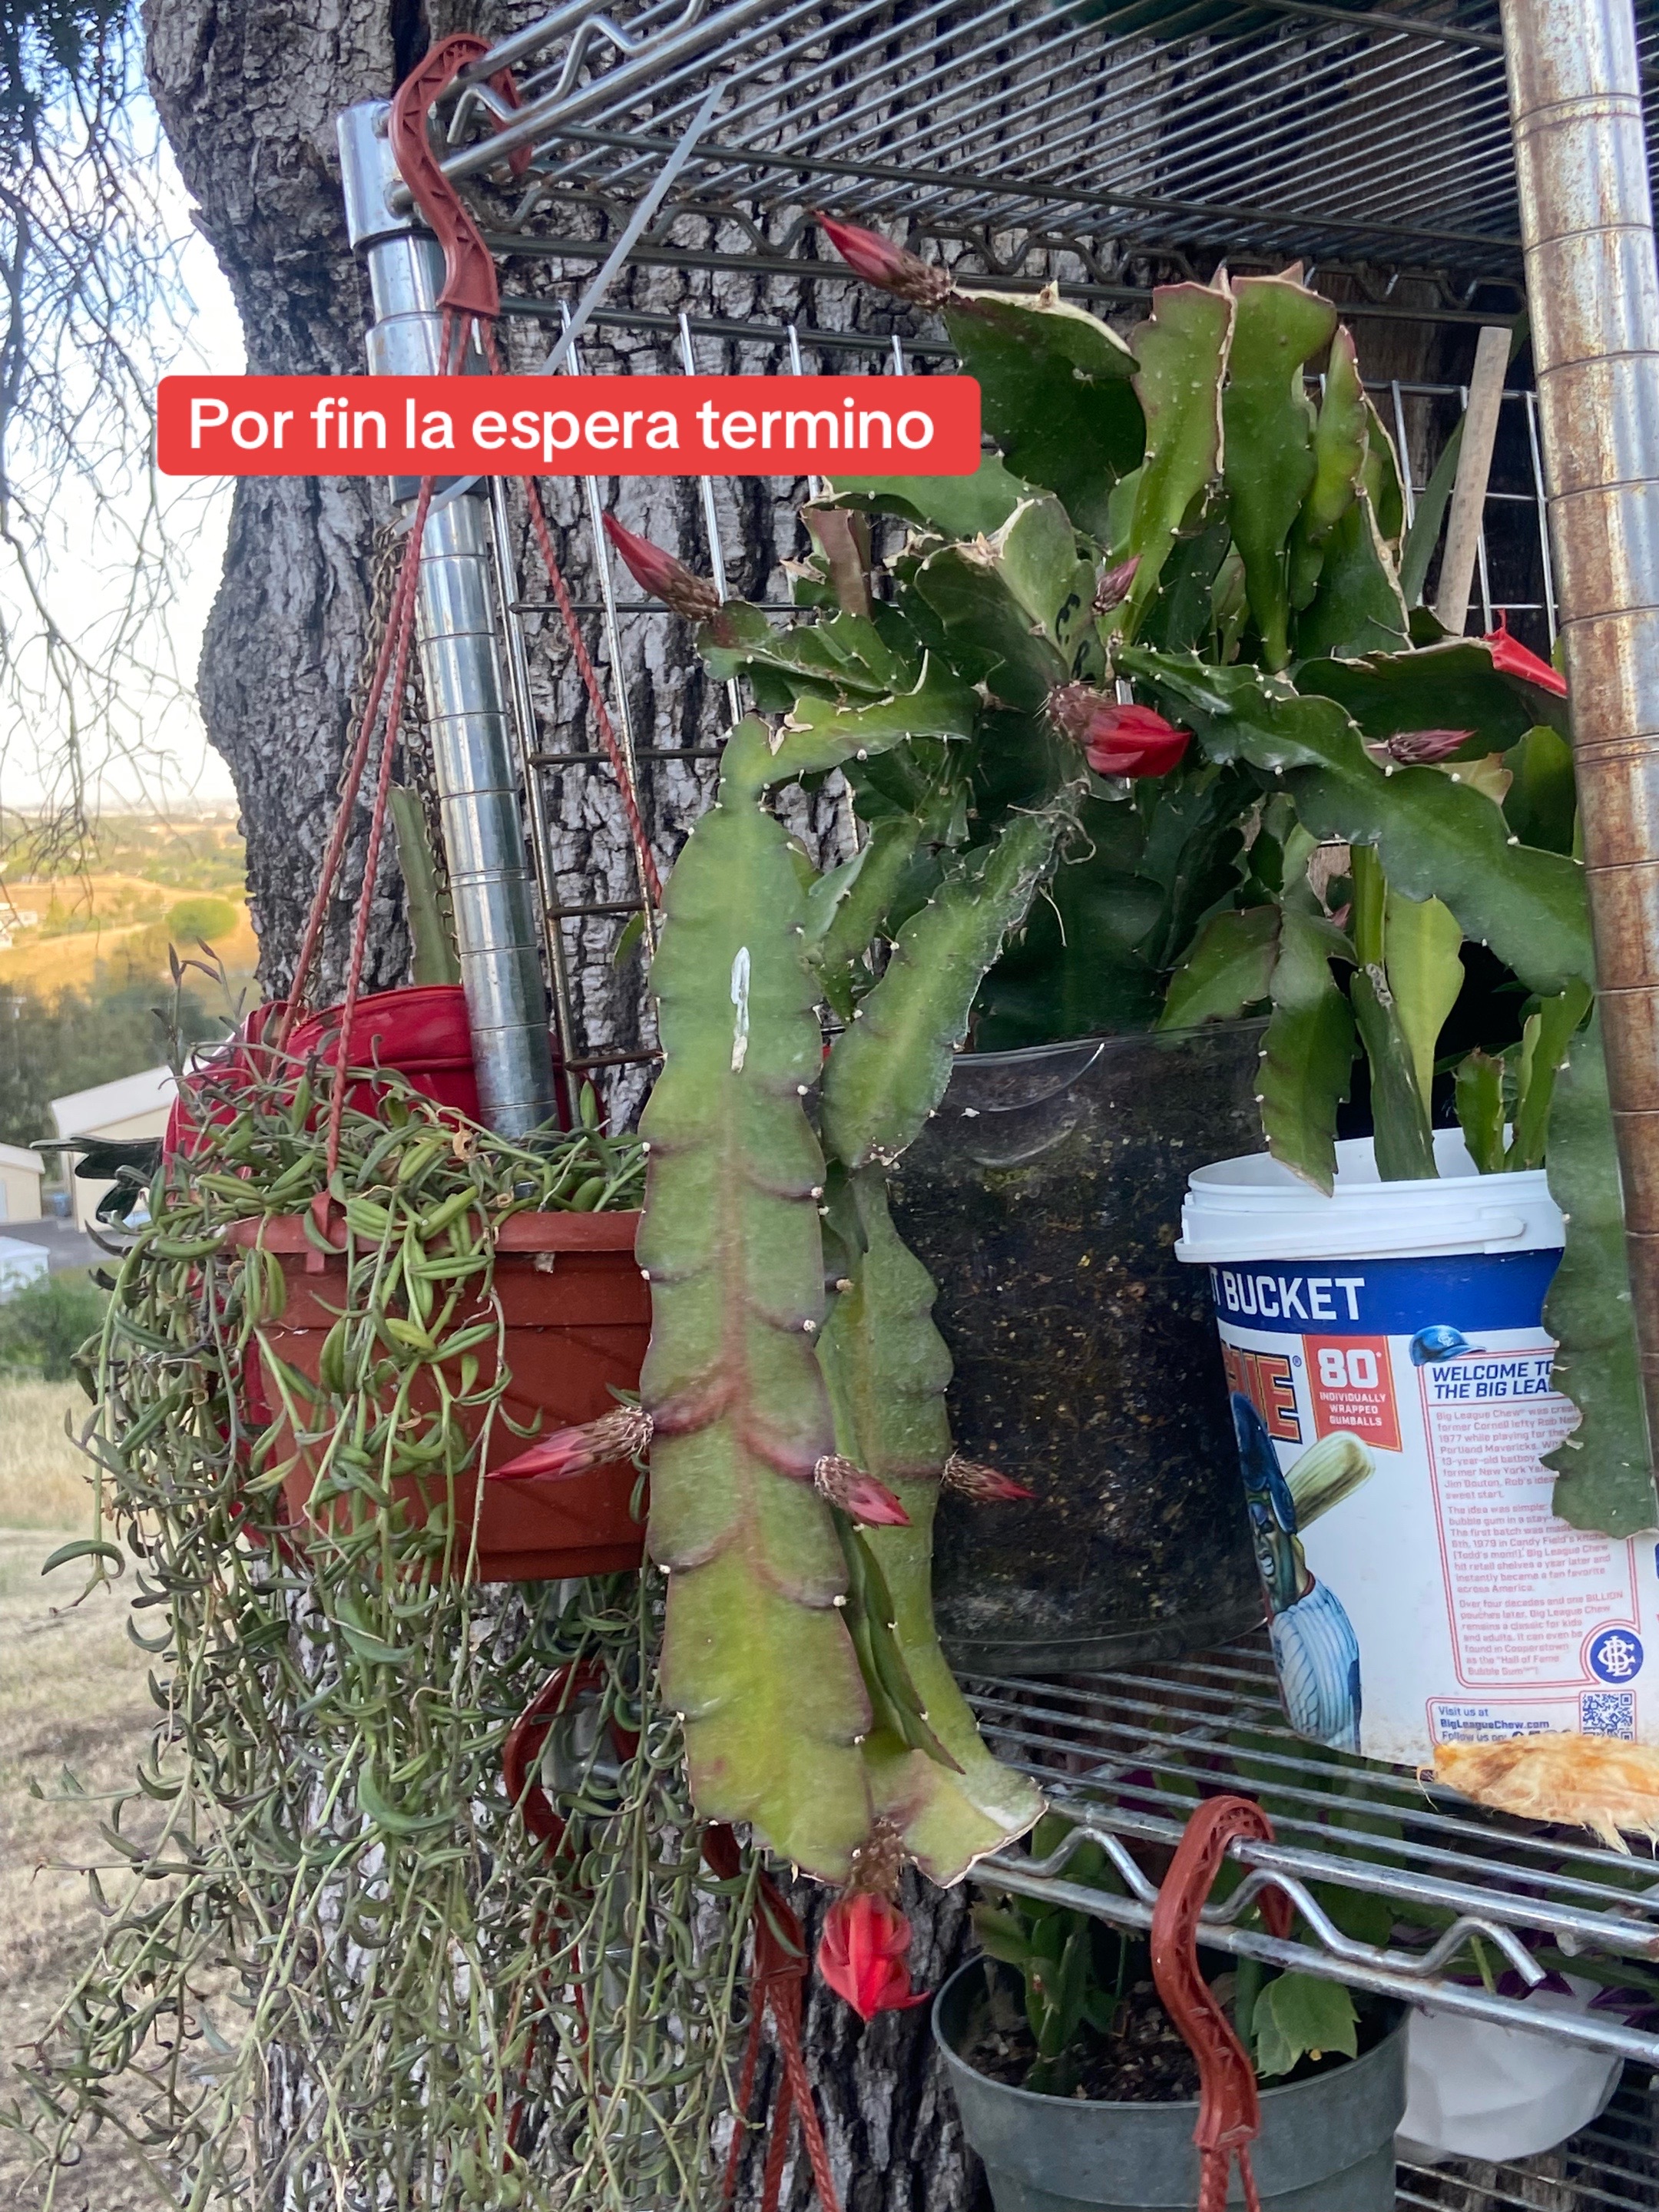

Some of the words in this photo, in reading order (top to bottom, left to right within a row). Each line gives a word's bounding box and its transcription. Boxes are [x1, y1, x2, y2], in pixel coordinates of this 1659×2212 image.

[1223, 1270, 1365, 1320] BUCKET
[1432, 1362, 1529, 1382] WELCOME
[1435, 1383, 1469, 1399] THE
[1476, 1382, 1507, 1396] BIG
[1513, 1379, 1559, 1395] LEA
[1320, 1392, 1386, 1402] INDIVIDUALLY
[1330, 1404, 1378, 1414] WRAPPED
[1330, 1415, 1382, 1426] GUMBALLS
[1438, 1422, 1471, 1432] former
[1493, 1432, 1528, 1442] playing
[1444, 1479, 1462, 1488] Jim
[1447, 1505, 1465, 1515] The
[1468, 1505, 1488, 1514] idea
[1483, 1518, 1505, 1526] gum
[1470, 1527, 1491, 1536] first
[1493, 1526, 1522, 1535] batch
[1582, 1544, 1608, 1553] Chew
[1568, 1557, 1591, 1565] later
[1593, 1554, 1611, 1562] and
[1584, 1604, 1610, 1613] Chew
[1438, 1706, 1461, 1716] Visit
[1440, 1719, 1549, 1730] BigLeagueChew.com
